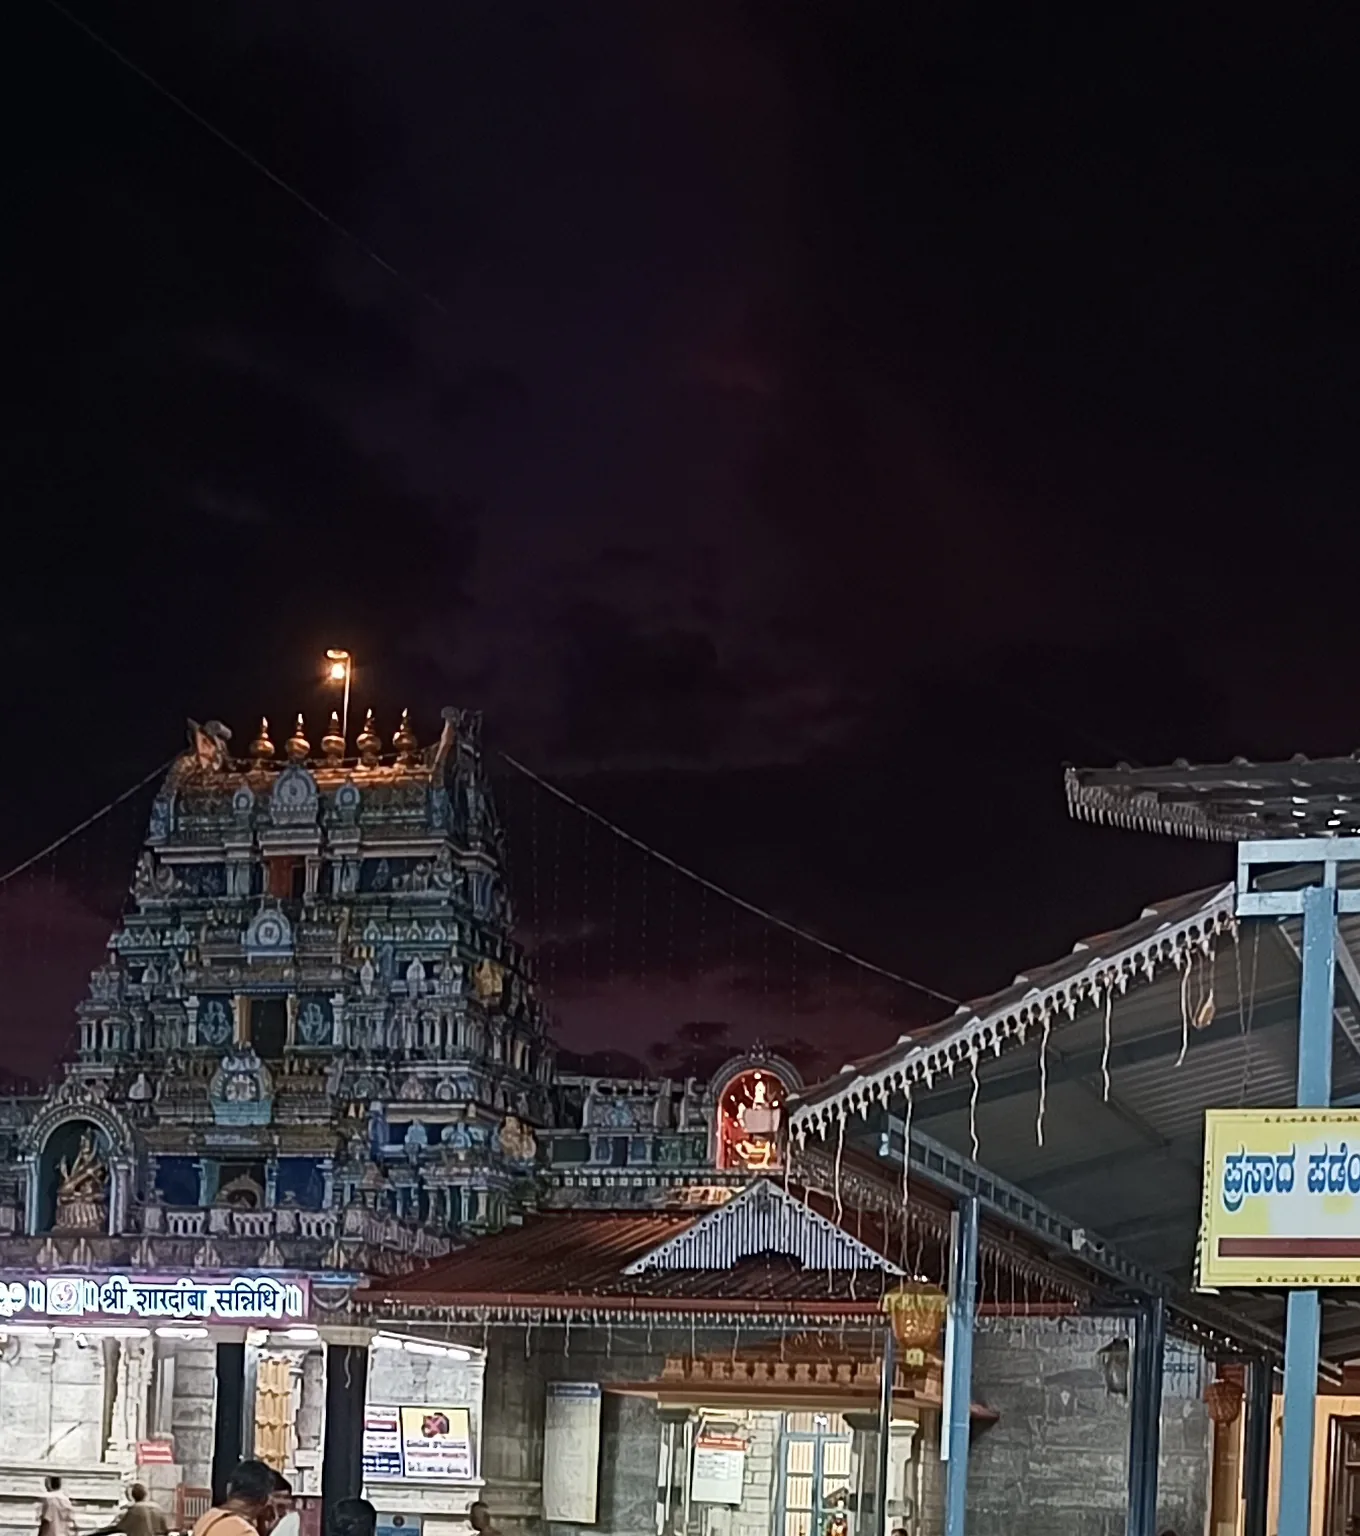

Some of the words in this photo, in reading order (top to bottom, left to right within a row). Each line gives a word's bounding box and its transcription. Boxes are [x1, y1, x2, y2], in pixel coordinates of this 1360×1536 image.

[1223, 1142, 1296, 1212] ಪ್ರಸಾದ
[102, 1279, 128, 1310] श्री
[133, 1281, 207, 1312] शारदांबा
[214, 1281, 280, 1313] सन्निधि
